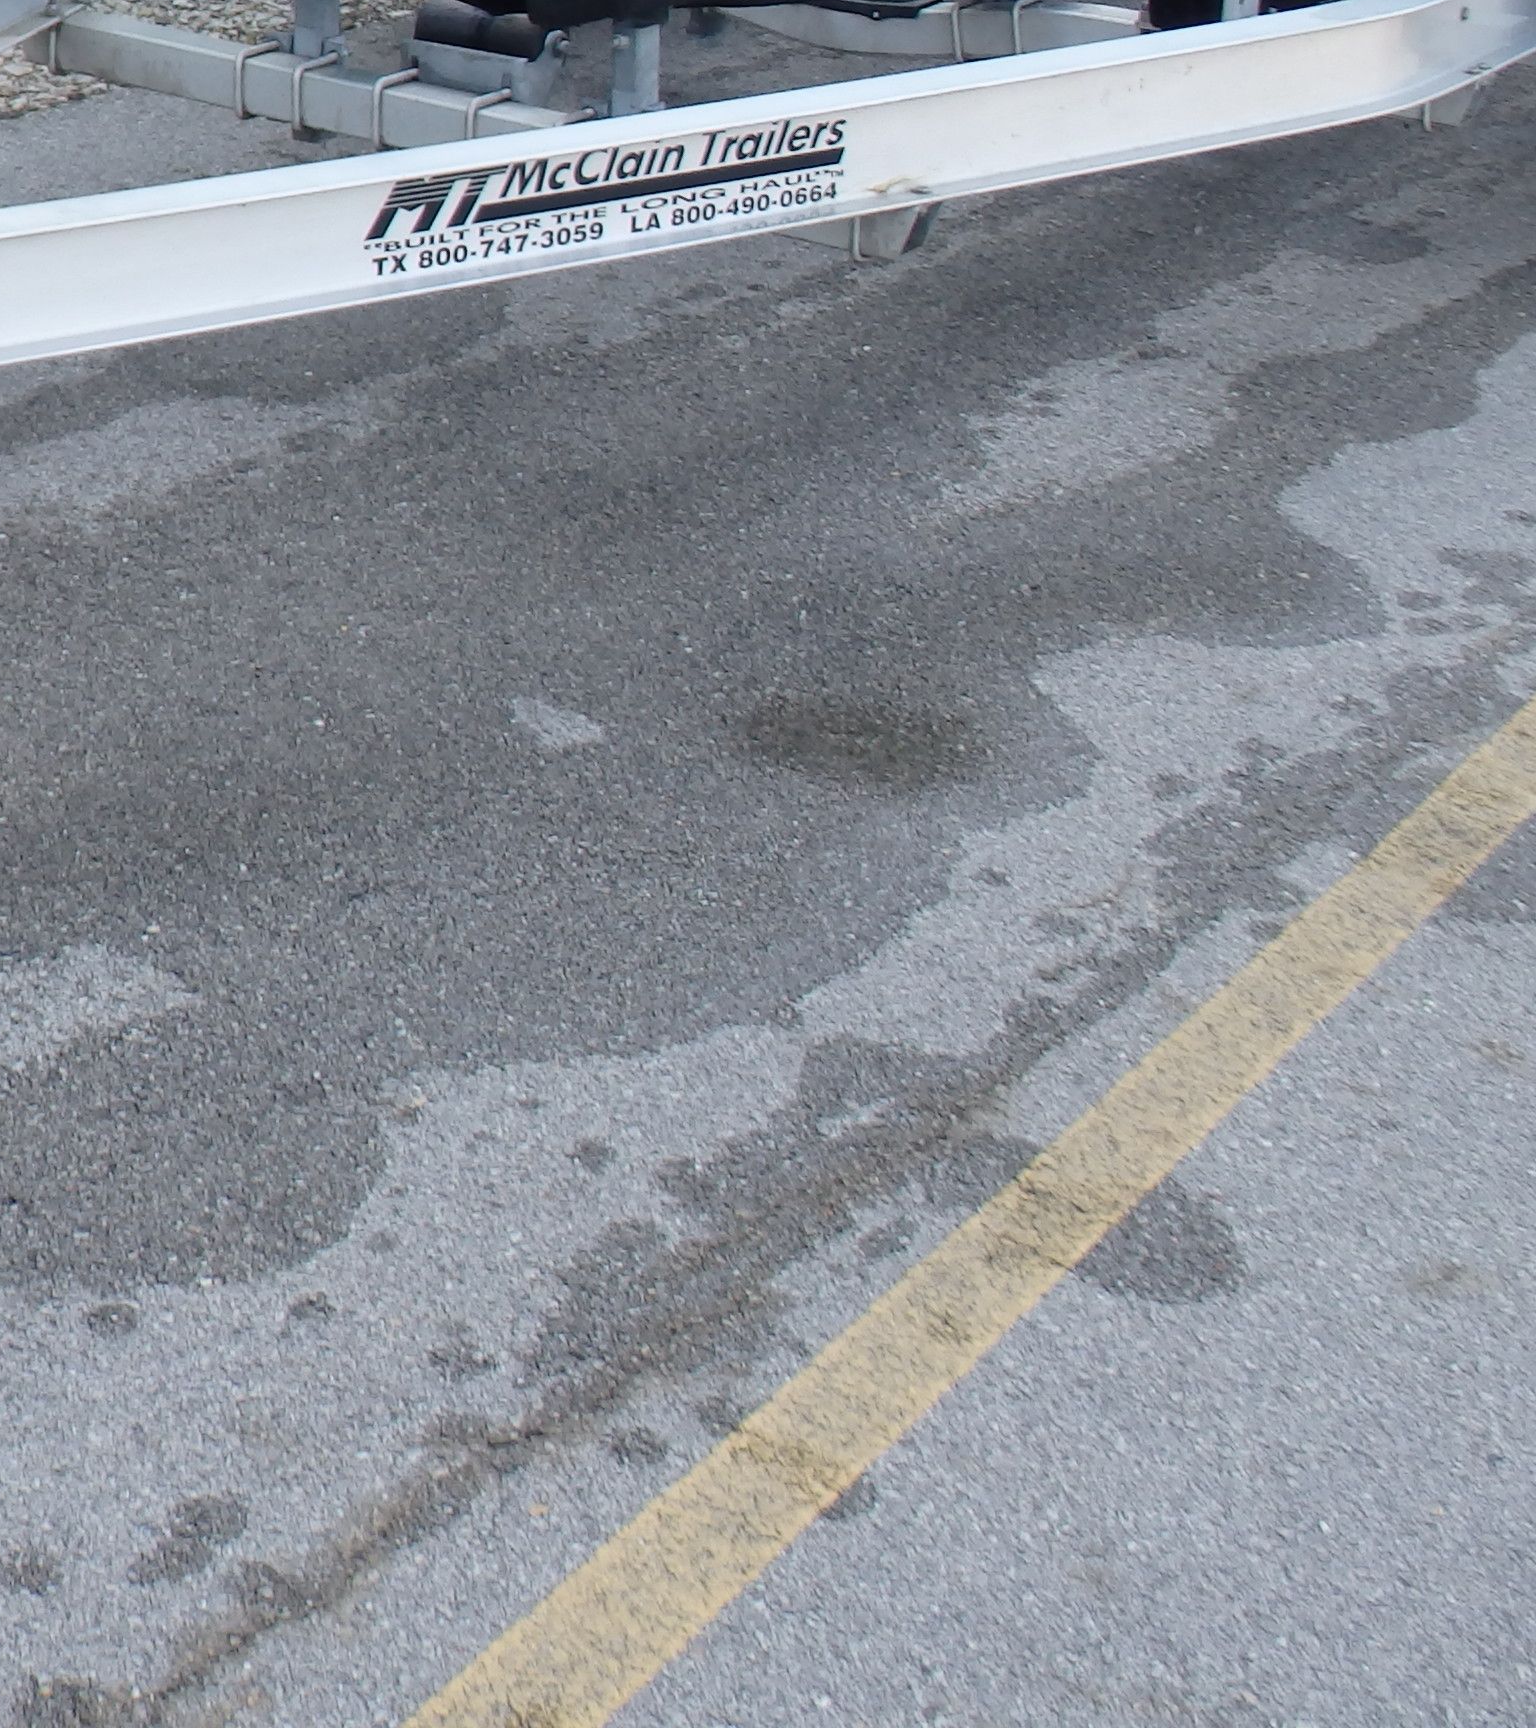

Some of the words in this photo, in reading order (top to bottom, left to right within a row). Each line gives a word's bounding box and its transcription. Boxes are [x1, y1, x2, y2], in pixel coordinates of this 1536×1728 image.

[499, 140, 685, 198] McClain
[699, 119, 847, 167] Trailers
[479, 217, 541, 235] FOR
[552, 206, 607, 225] THE
[621, 187, 726, 214] LONG
[630, 212, 661, 233] LA
[671, 181, 838, 226] 800-490-0664
[372, 252, 407, 276] TX
[418, 221, 604, 269] 800-747-3059
